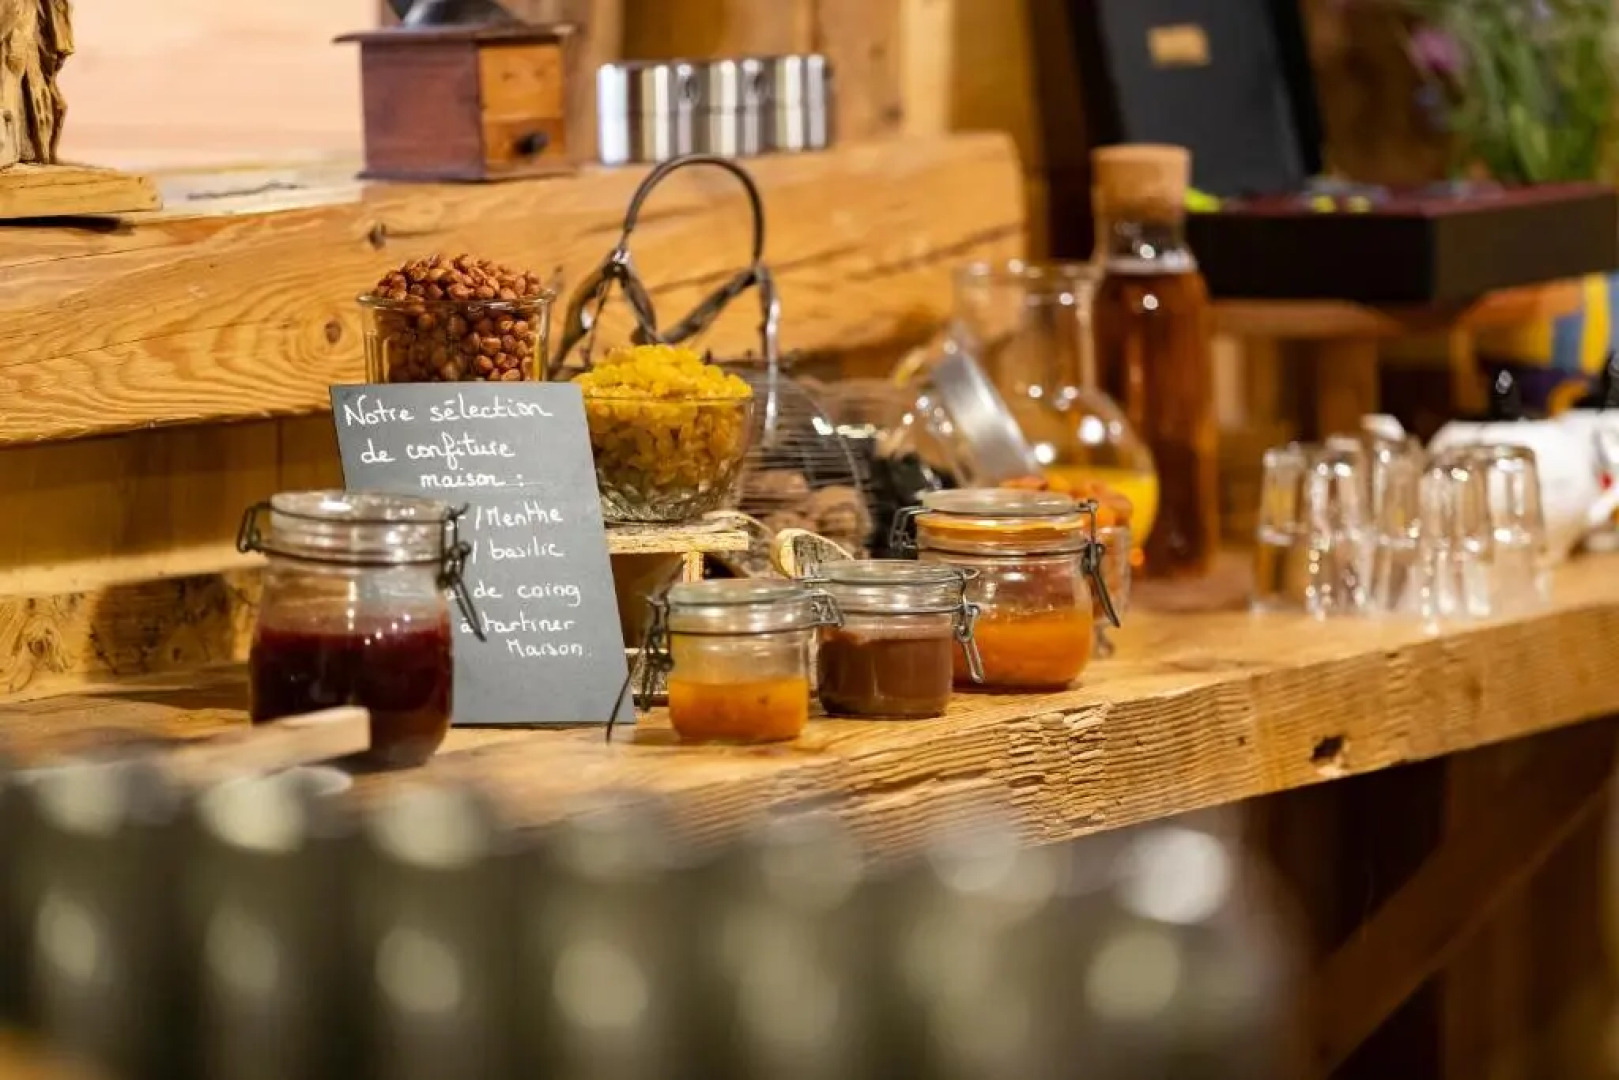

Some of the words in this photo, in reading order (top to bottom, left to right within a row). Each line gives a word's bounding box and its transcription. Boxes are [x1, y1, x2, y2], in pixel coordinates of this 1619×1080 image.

[344, 394, 415, 426] Notre
[429, 391, 553, 422] sélection
[361, 438, 396, 464] de
[406, 431, 516, 470] confiture
[473, 579, 503, 599] de
[517, 582, 581, 607] coing
[481, 610, 576, 632] tartiner
